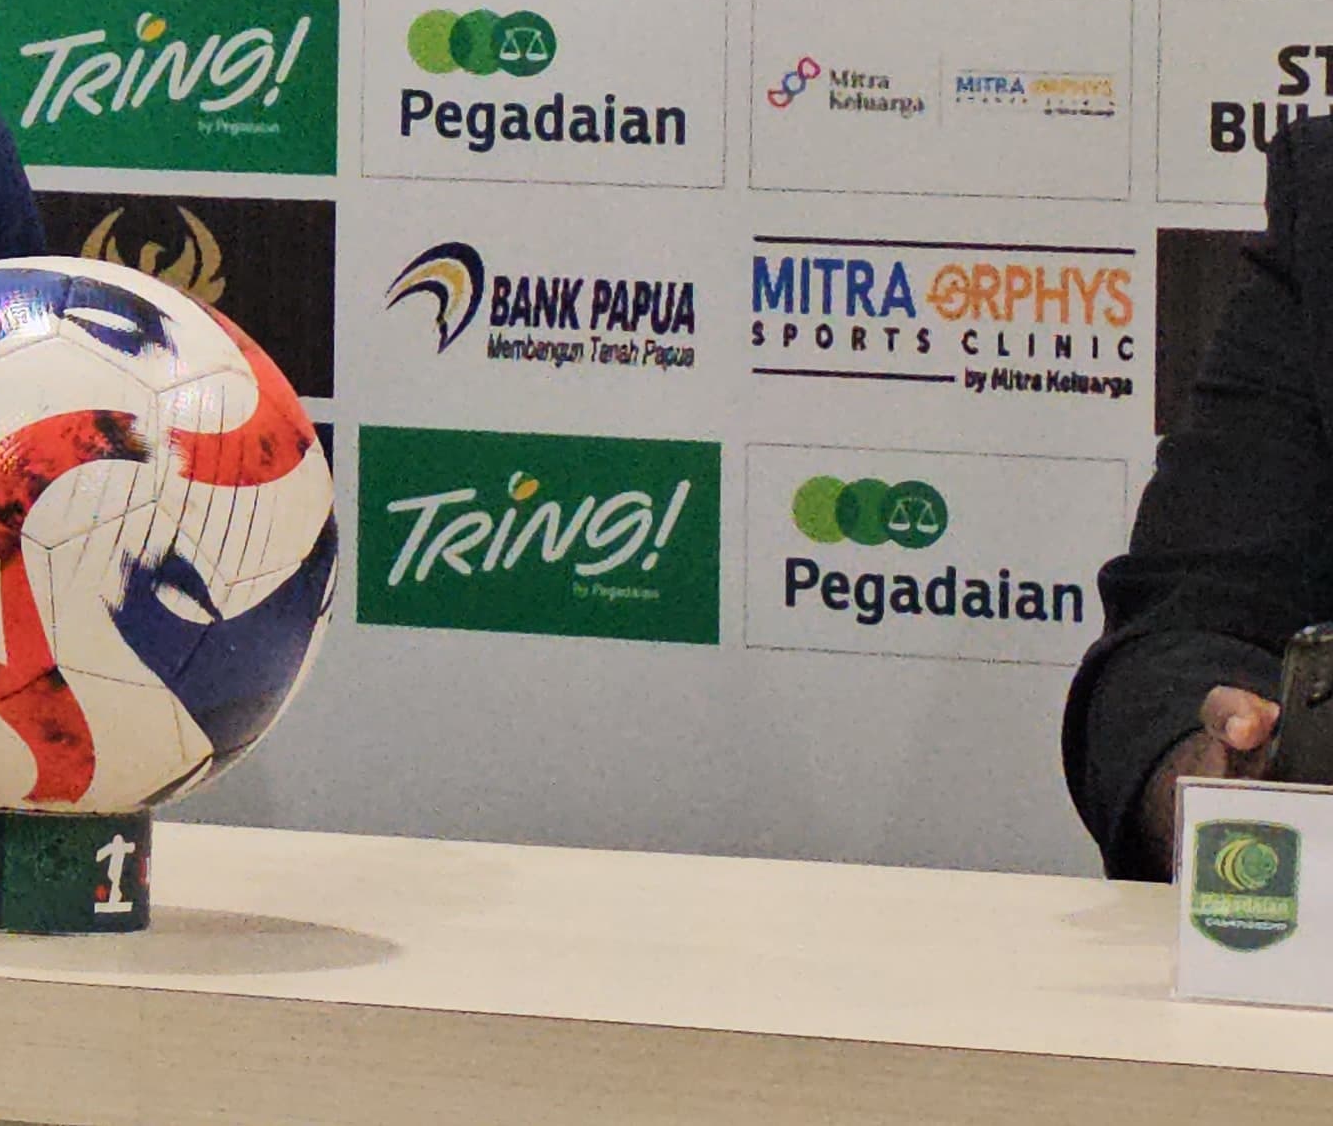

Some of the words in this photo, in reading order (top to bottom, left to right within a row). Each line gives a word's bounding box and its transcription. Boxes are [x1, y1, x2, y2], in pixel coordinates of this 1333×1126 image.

[401, 89, 685, 152] Pegadaian
[490, 276, 584, 330] BANK
[590, 280, 695, 335] PAPUA
[753, 257, 917, 318] MITRA
[927, 263, 1134, 327] ORPHYS
[590, 336, 637, 364] Tanah
[642, 338, 694, 370] Papua
[751, 322, 931, 354] SPORTS
[962, 330, 1134, 361] CLINIC
[965, 370, 986, 393] by
[991, 370, 1042, 392] Mitra
[1047, 371, 1133, 396] Keluarga
[786, 558, 1083, 625] Pegadaian
